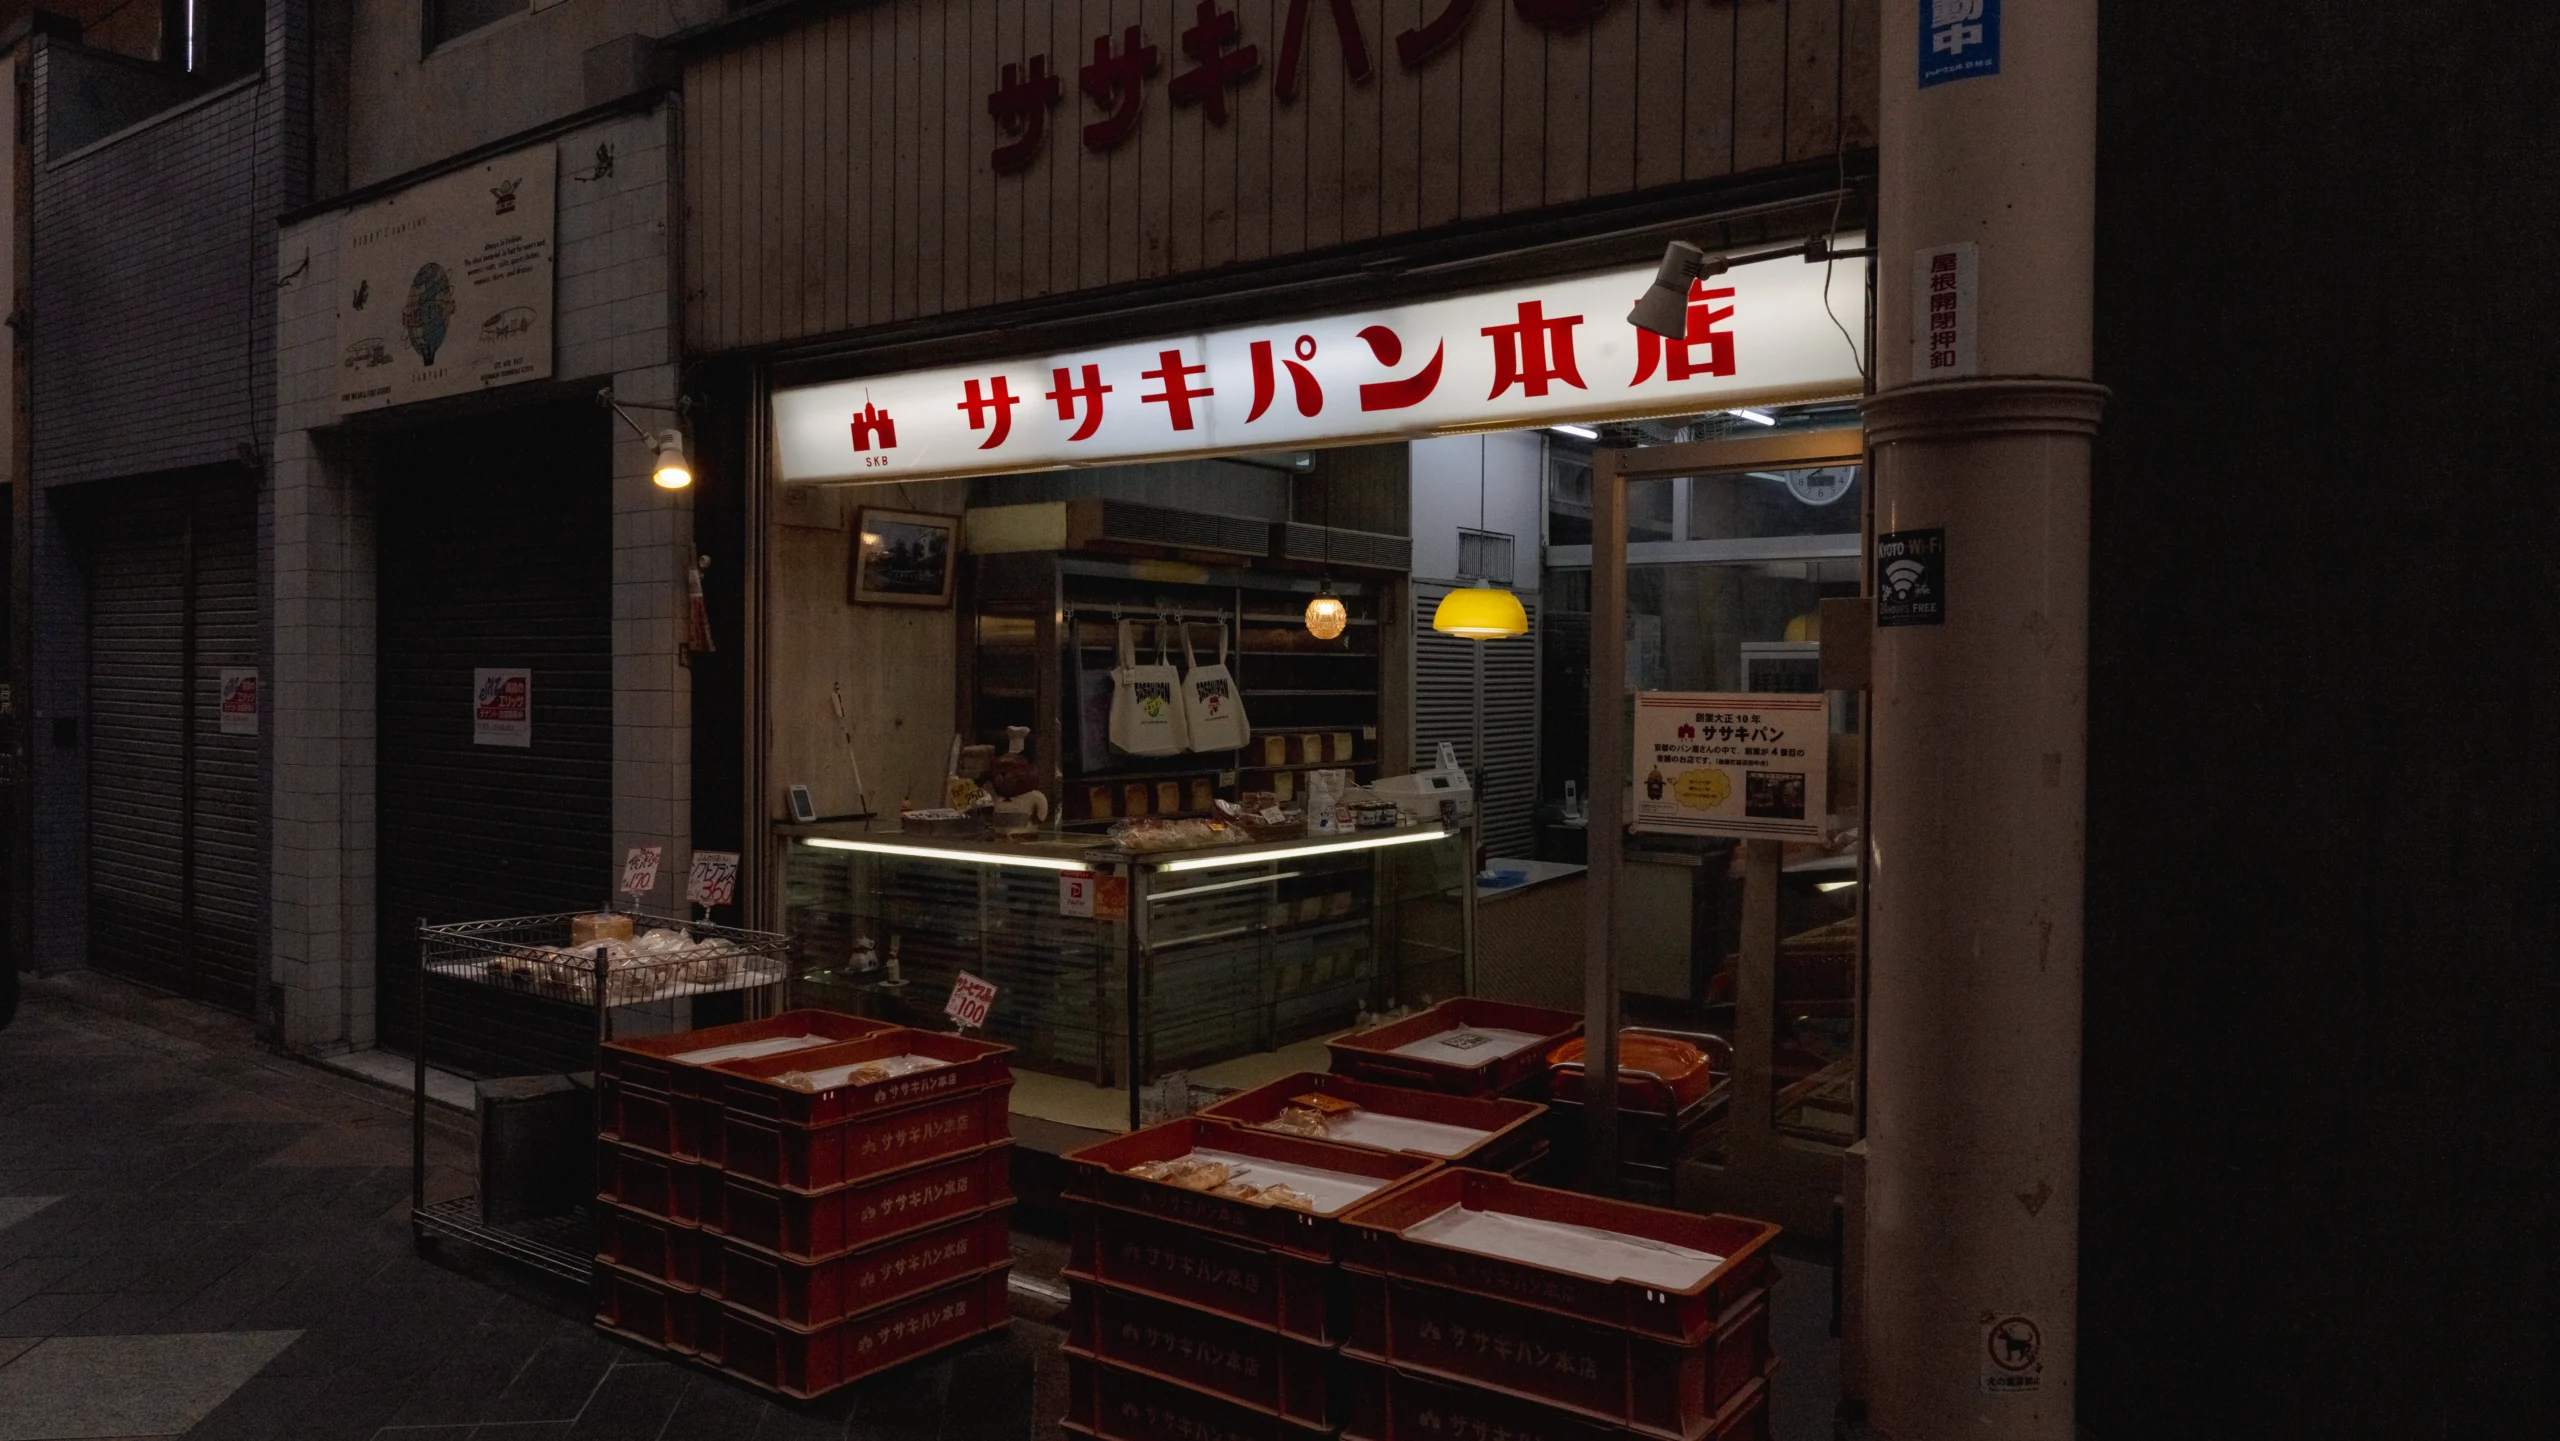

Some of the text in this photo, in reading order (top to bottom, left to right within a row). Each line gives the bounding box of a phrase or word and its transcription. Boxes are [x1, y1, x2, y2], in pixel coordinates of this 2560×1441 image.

[1930, 253, 1957, 369] 屋根開閉押釦
[957, 278, 1736, 450] ササキパン本店
[866, 456, 888, 467] SKB
[1879, 537, 1942, 558] KYOTO Wi-Fi
[1913, 602, 1937, 613] FREE
[1737, 715, 1748, 723] 10
[1702, 726, 1784, 742] ササキパン
[957, 997, 985, 1023] 100
